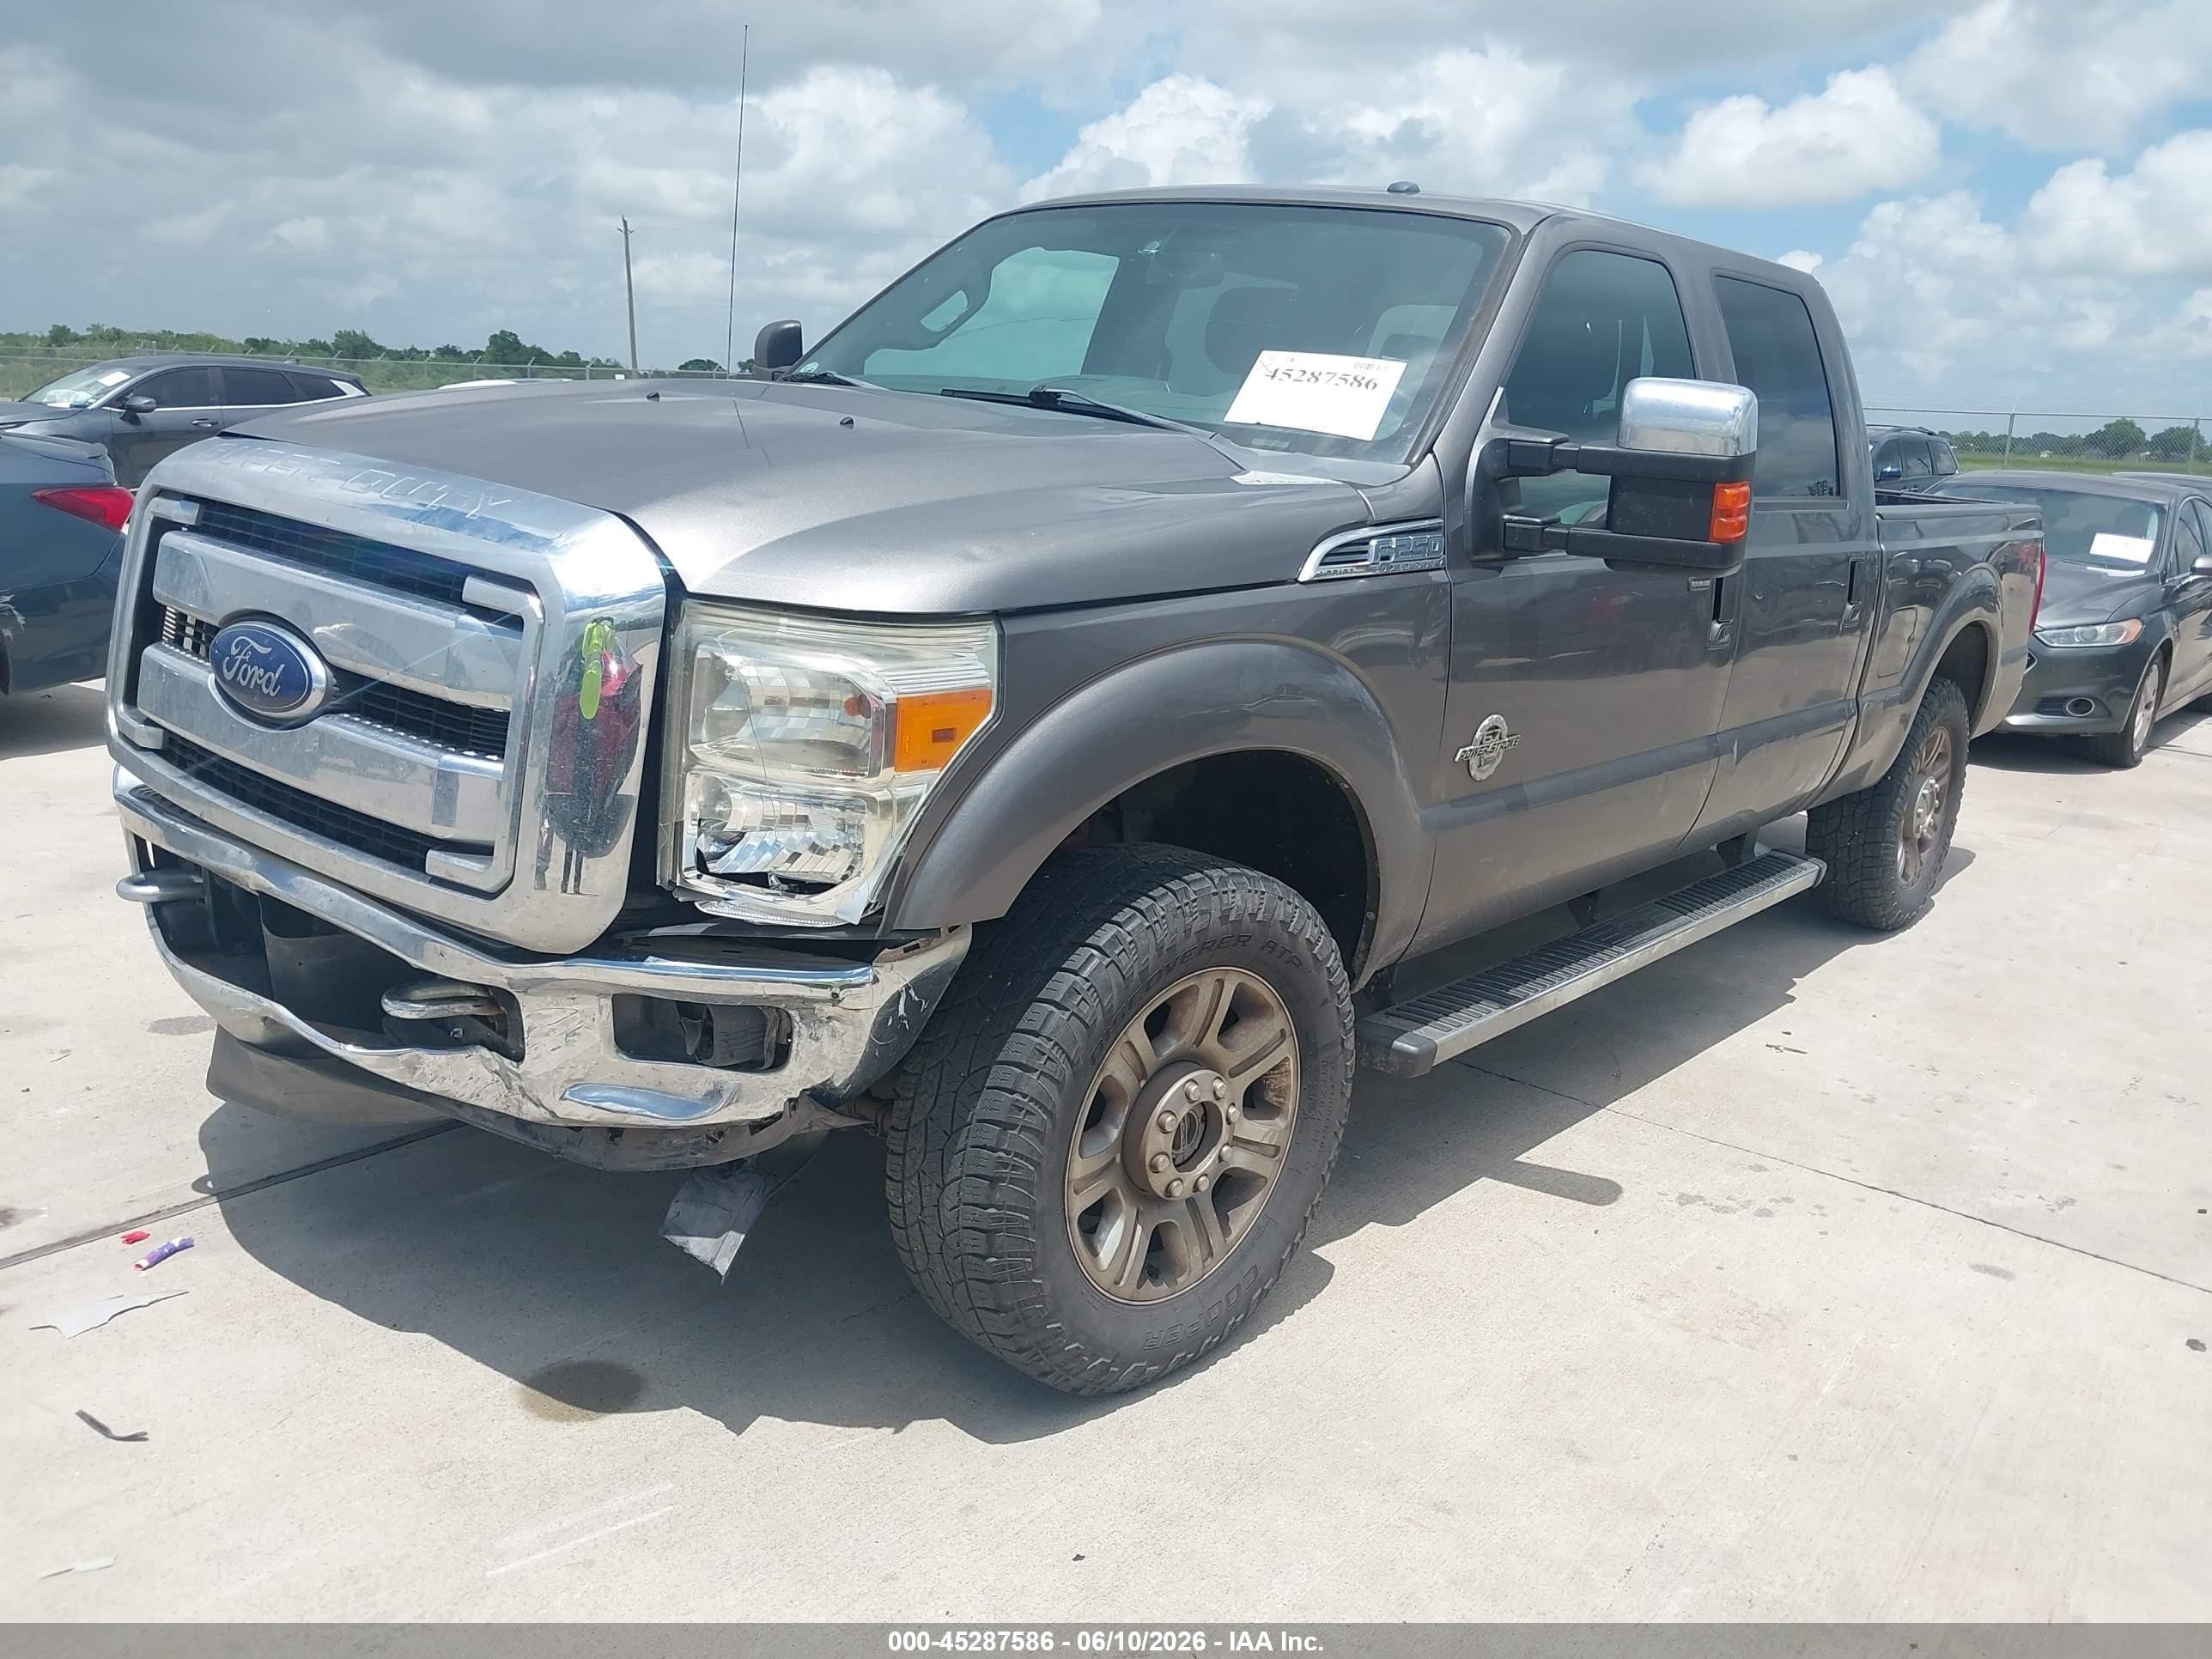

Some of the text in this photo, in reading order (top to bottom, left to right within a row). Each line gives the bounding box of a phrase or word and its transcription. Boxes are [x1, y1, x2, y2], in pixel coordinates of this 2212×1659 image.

[1264, 366, 1379, 391] 45287586
[222, 635, 286, 697] Ford
[1142, 1264, 1259, 1351] COOPER
